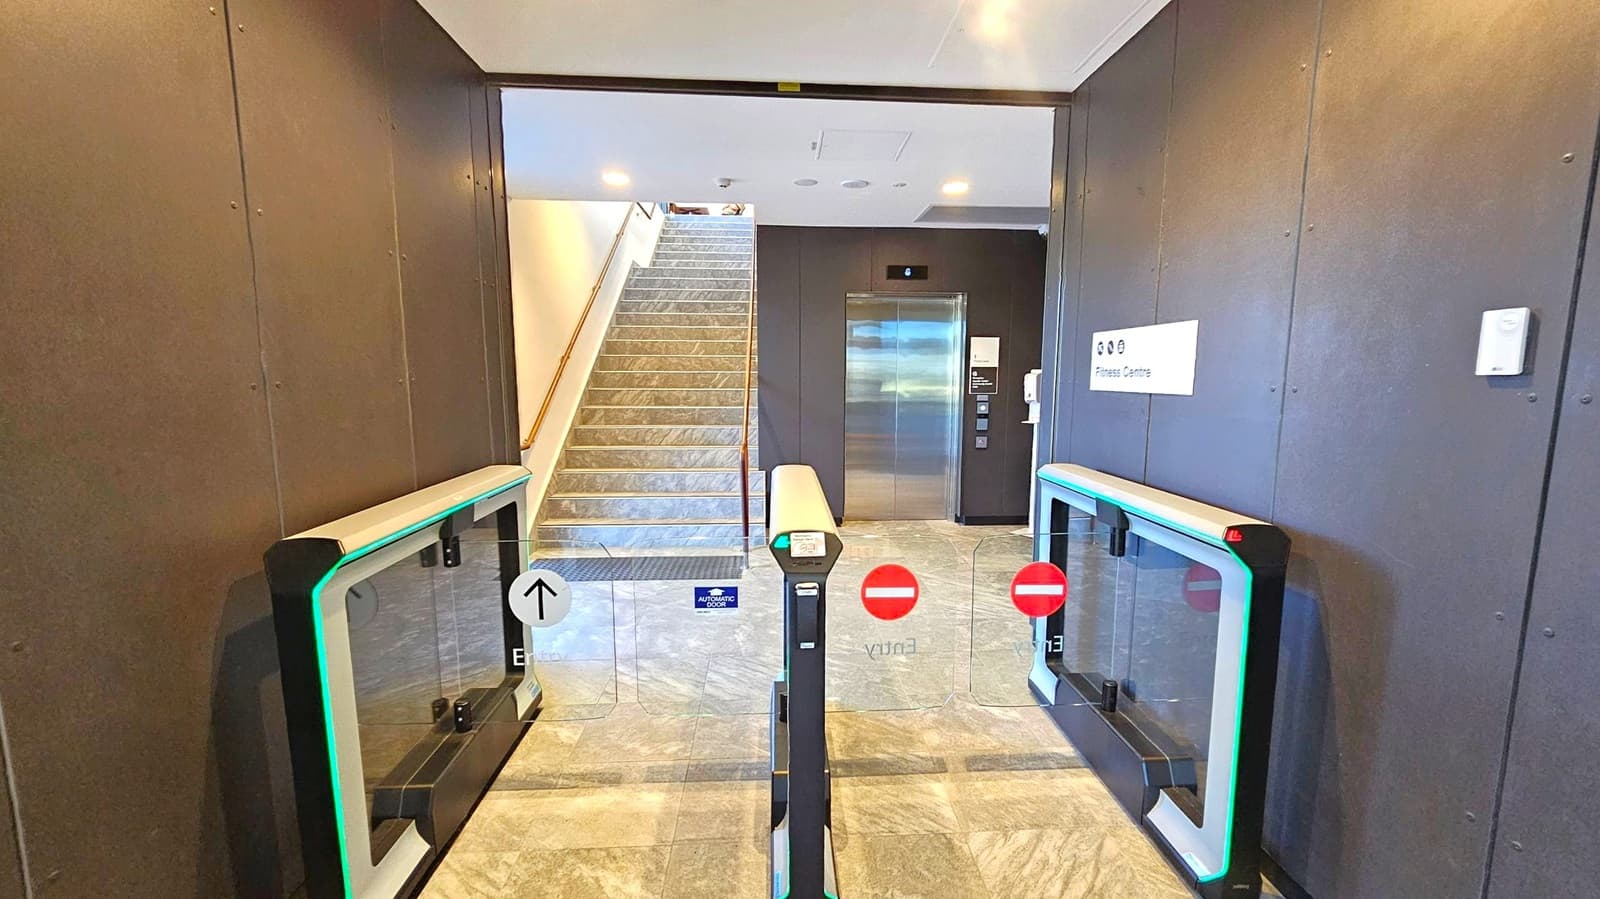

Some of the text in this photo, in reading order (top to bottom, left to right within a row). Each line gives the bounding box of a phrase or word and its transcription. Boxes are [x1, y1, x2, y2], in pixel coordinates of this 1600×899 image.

[1096, 365, 1152, 378] Fitness Centre
[697, 595, 736, 603] AUTOMATIC
